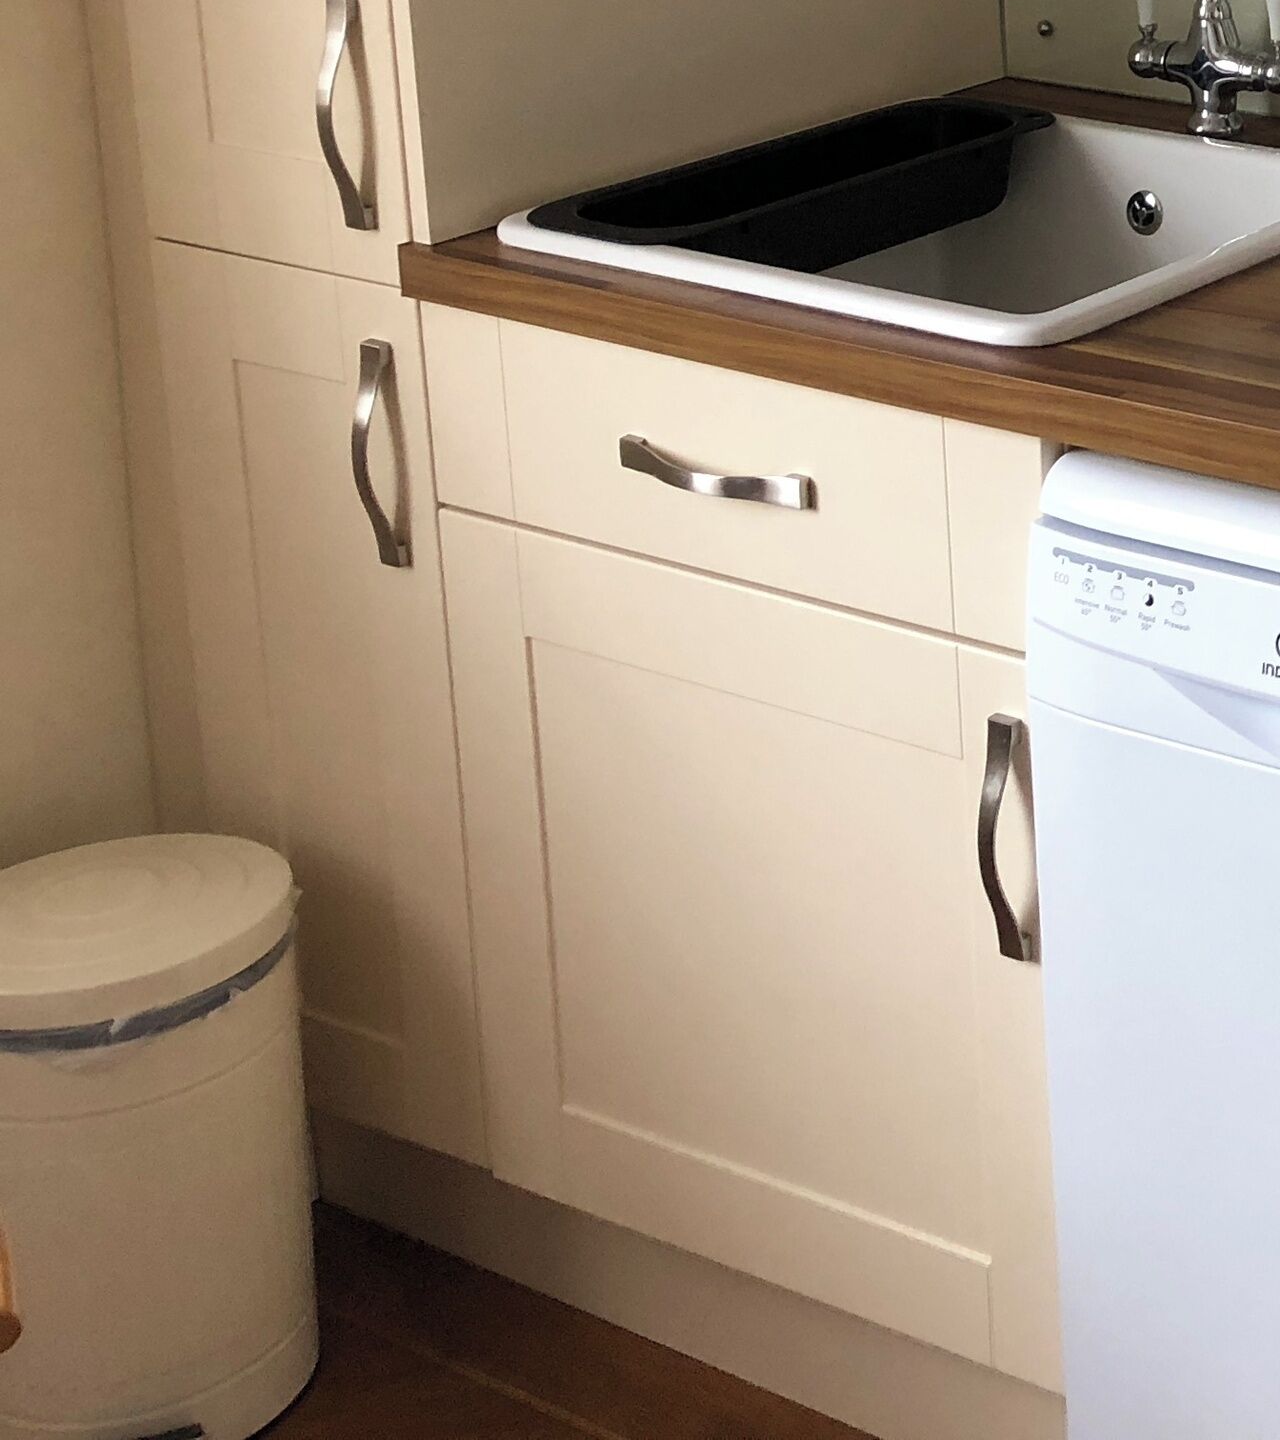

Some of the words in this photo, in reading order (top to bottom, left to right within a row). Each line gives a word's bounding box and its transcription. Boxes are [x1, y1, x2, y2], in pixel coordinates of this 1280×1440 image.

[1087, 564, 1093, 573] 2
[1054, 571, 1069, 584] ECO
[1117, 572, 1122, 581] 3
[1147, 580, 1153, 588] 4
[1177, 586, 1183, 595] 5
